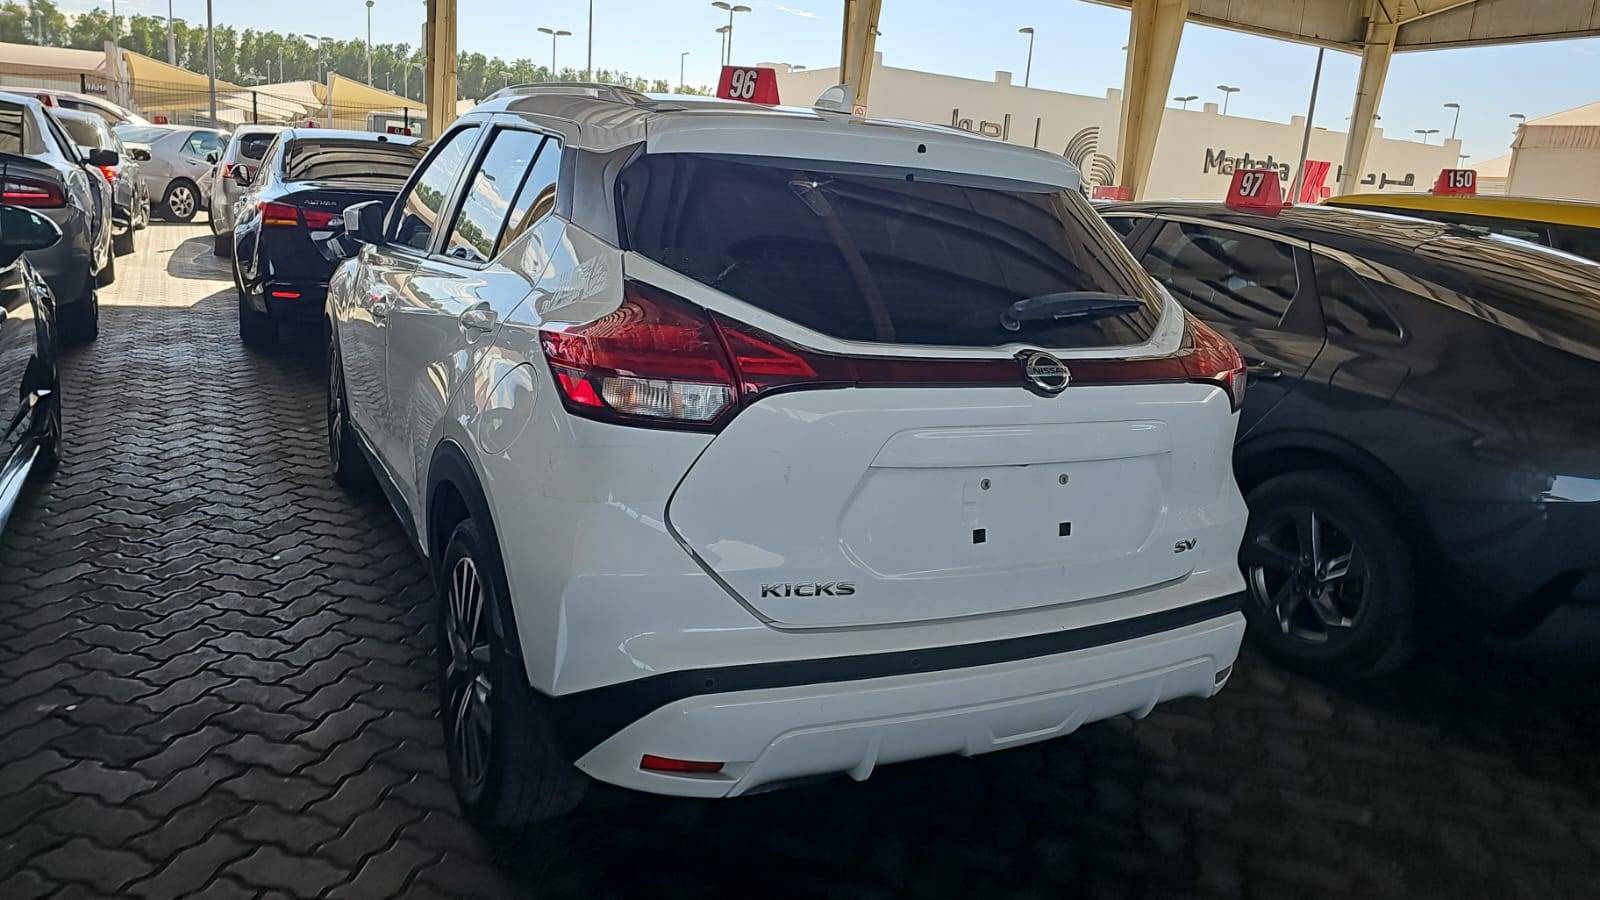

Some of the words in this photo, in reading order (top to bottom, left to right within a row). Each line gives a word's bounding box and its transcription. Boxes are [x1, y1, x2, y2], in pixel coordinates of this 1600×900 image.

[730, 69, 757, 99] 96
[1240, 172, 1265, 198] 97
[1449, 170, 1473, 188] 150
[1033, 366, 1067, 376] NISSAN
[1174, 537, 1198, 554] SV
[760, 582, 856, 598] KICKS
